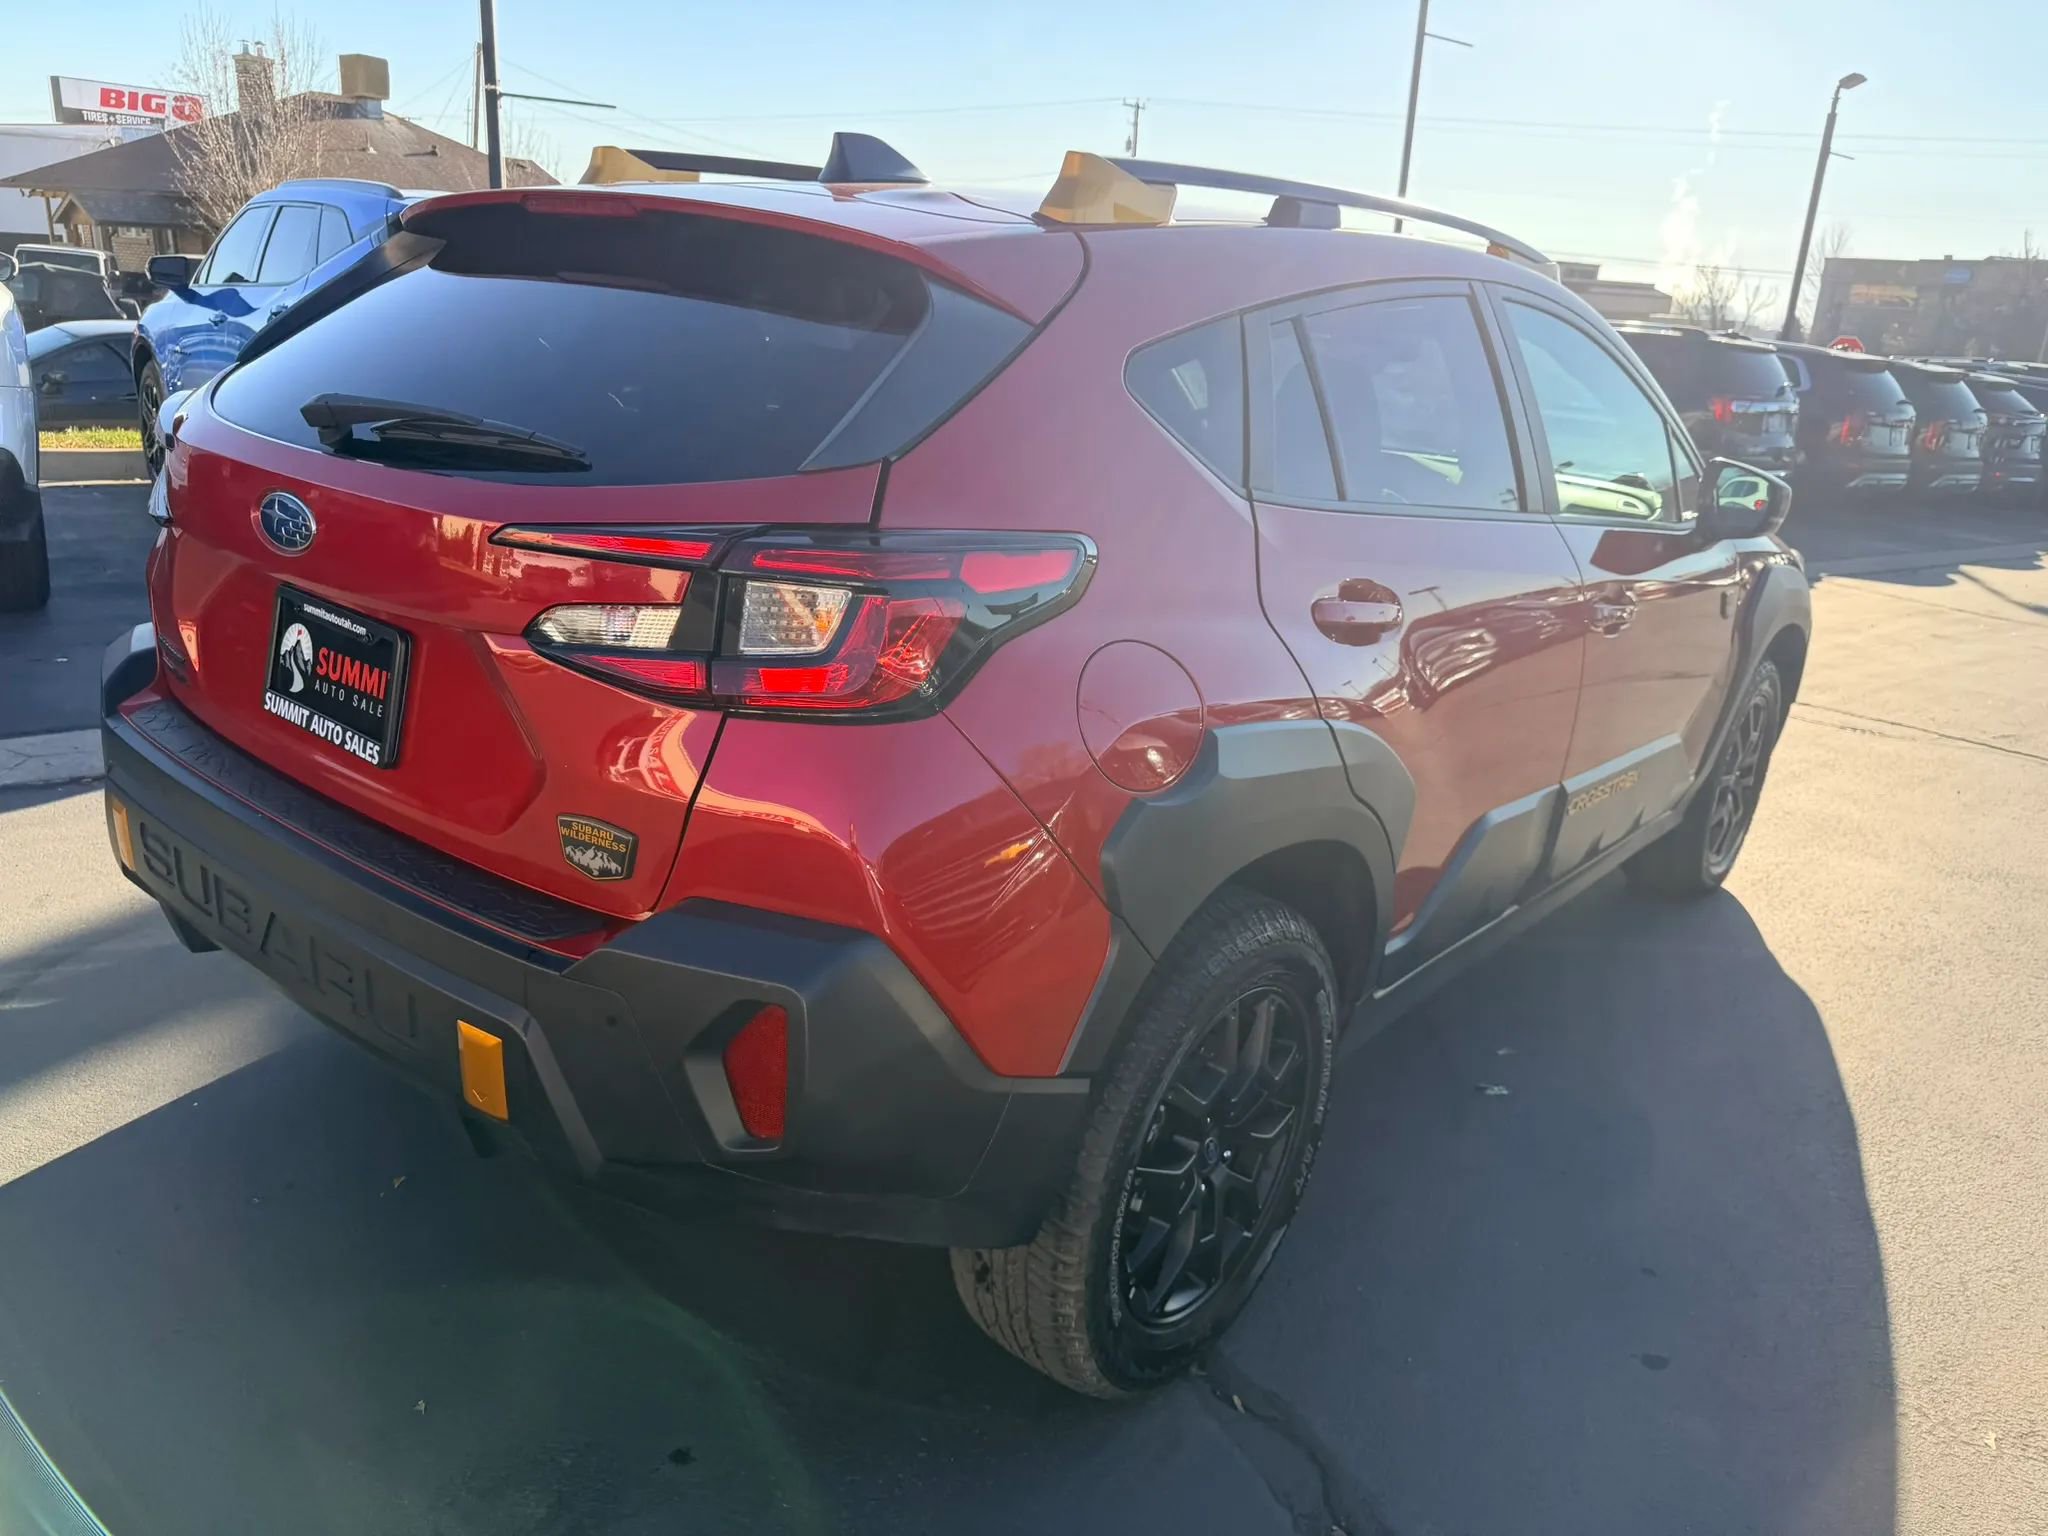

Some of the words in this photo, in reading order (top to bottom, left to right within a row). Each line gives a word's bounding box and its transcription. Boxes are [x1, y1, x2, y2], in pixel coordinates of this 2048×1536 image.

[81, 110, 108, 123] TIRES
[115, 114, 151, 125] SERVICE
[100, 88, 167, 114] BIG
[303, 603, 367, 636] summitautoutah.com
[316, 647, 391, 700] SUMMI
[315, 680, 345, 701] AUTO
[352, 694, 384, 718] SALE
[264, 692, 310, 728] SUMMIT
[310, 714, 343, 745] AUTO
[344, 731, 381, 765] SALES
[560, 826, 627, 853] WILDERNESS
[572, 822, 614, 841] SUBARU
[139, 821, 419, 1052] SUBARU
